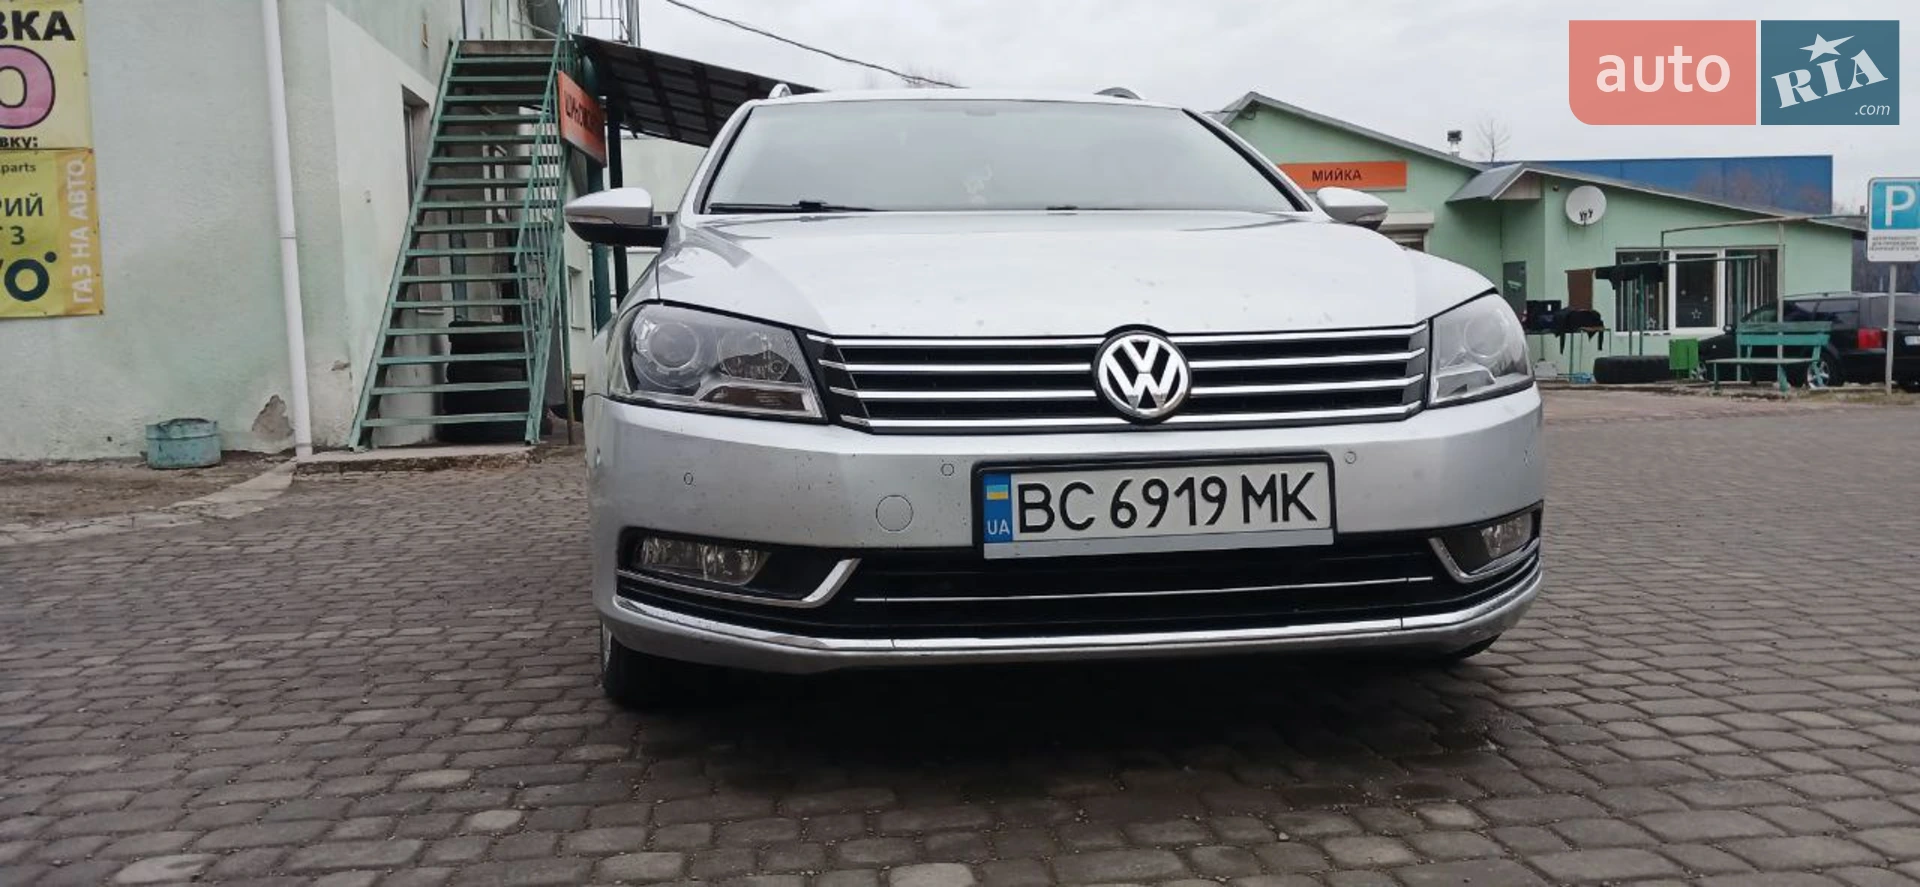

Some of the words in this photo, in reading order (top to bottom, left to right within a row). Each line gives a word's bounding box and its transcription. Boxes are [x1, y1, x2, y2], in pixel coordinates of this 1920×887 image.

[66, 158, 89, 221] АВТО
[1311, 168, 1362, 182] МИЙКА
[0, 192, 44, 217] ИЙ
[1885, 185, 1916, 227] P
[69, 226, 90, 259] НА
[71, 264, 93, 304] ГАЗ
[1017, 481, 1096, 534] BC
[1109, 475, 1228, 530] 6919
[1240, 471, 1318, 525] MK
[987, 518, 1011, 536] UA
